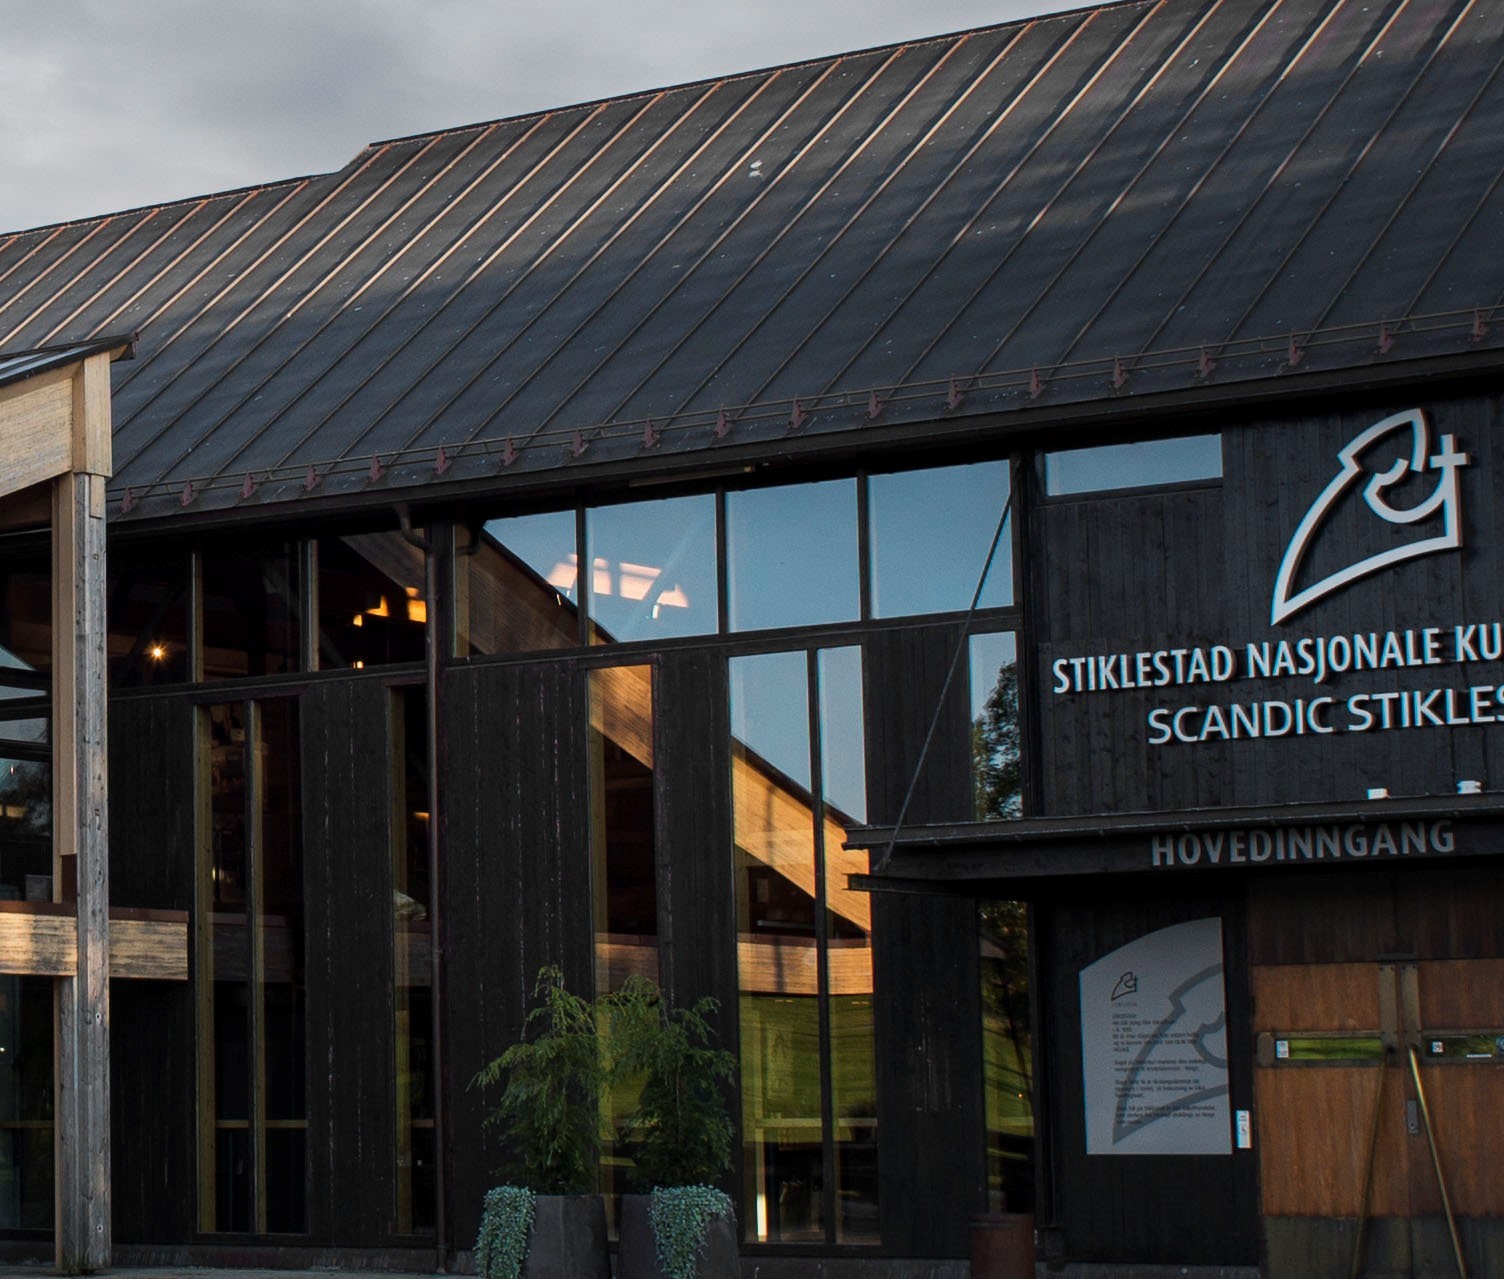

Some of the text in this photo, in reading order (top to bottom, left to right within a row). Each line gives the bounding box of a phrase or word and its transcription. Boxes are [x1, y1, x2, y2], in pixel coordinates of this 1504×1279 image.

[1052, 645, 1235, 694] STIKLESTAD
[1246, 627, 1442, 685] NASJONALE
[1147, 696, 1334, 745] SCANDIC
[1151, 820, 1456, 867] HOVEDINNGANG
